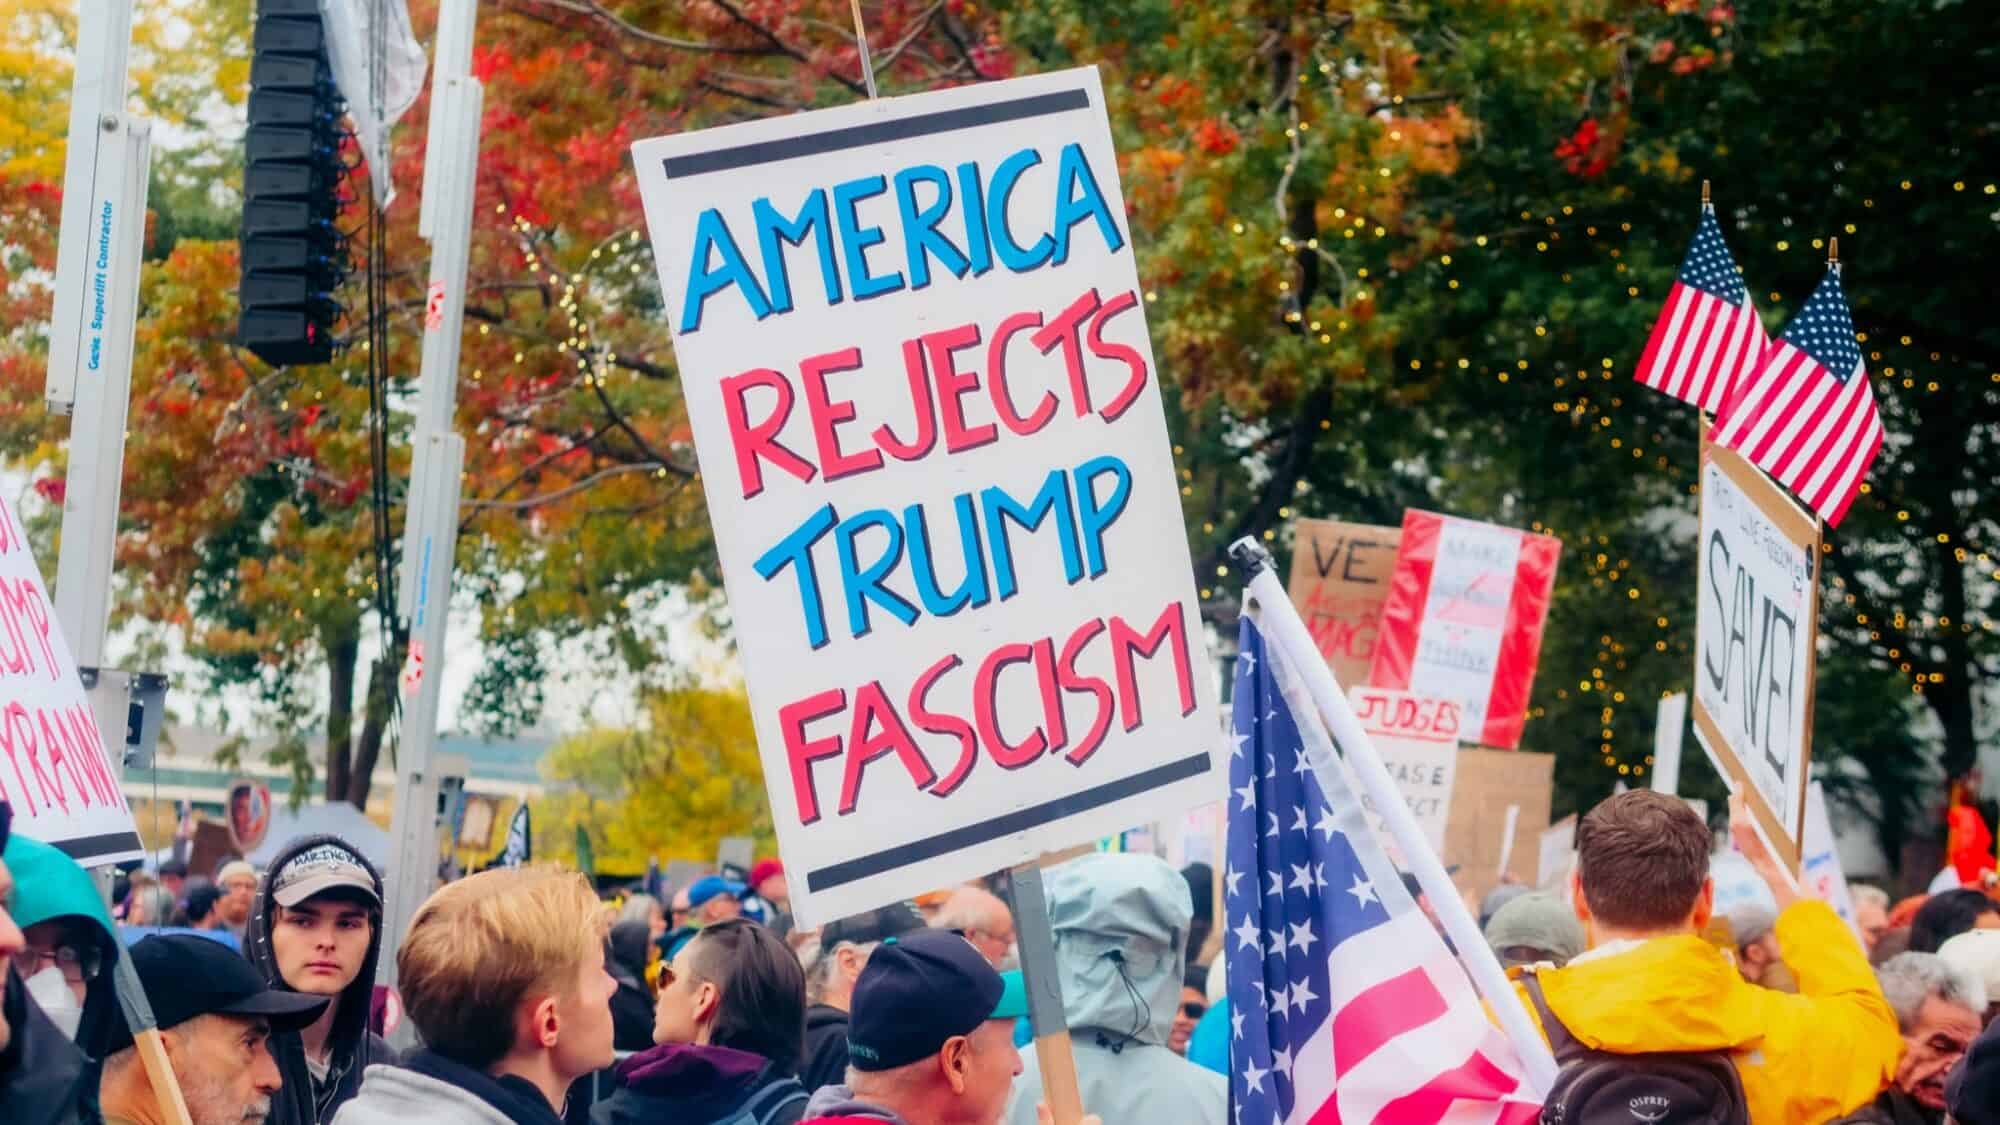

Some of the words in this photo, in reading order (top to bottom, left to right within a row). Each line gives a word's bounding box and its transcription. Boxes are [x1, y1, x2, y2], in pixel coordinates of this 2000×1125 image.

[96, 200, 113, 269] Contractor
[680, 143, 1124, 335] AMERICA
[91, 273, 107, 331] Superlift
[88, 336, 101, 370] Genie
[720, 288, 1148, 500] REJECTS
[752, 455, 1133, 651] TRUMP
[1311, 534, 1400, 584] VE
[0, 575, 60, 681] UMP
[778, 602, 1197, 826] FASCISM
[1357, 696, 1461, 735] JUDGES
[0, 700, 127, 817] YRANNY
[1629, 1095, 1671, 1108] OSPREY
